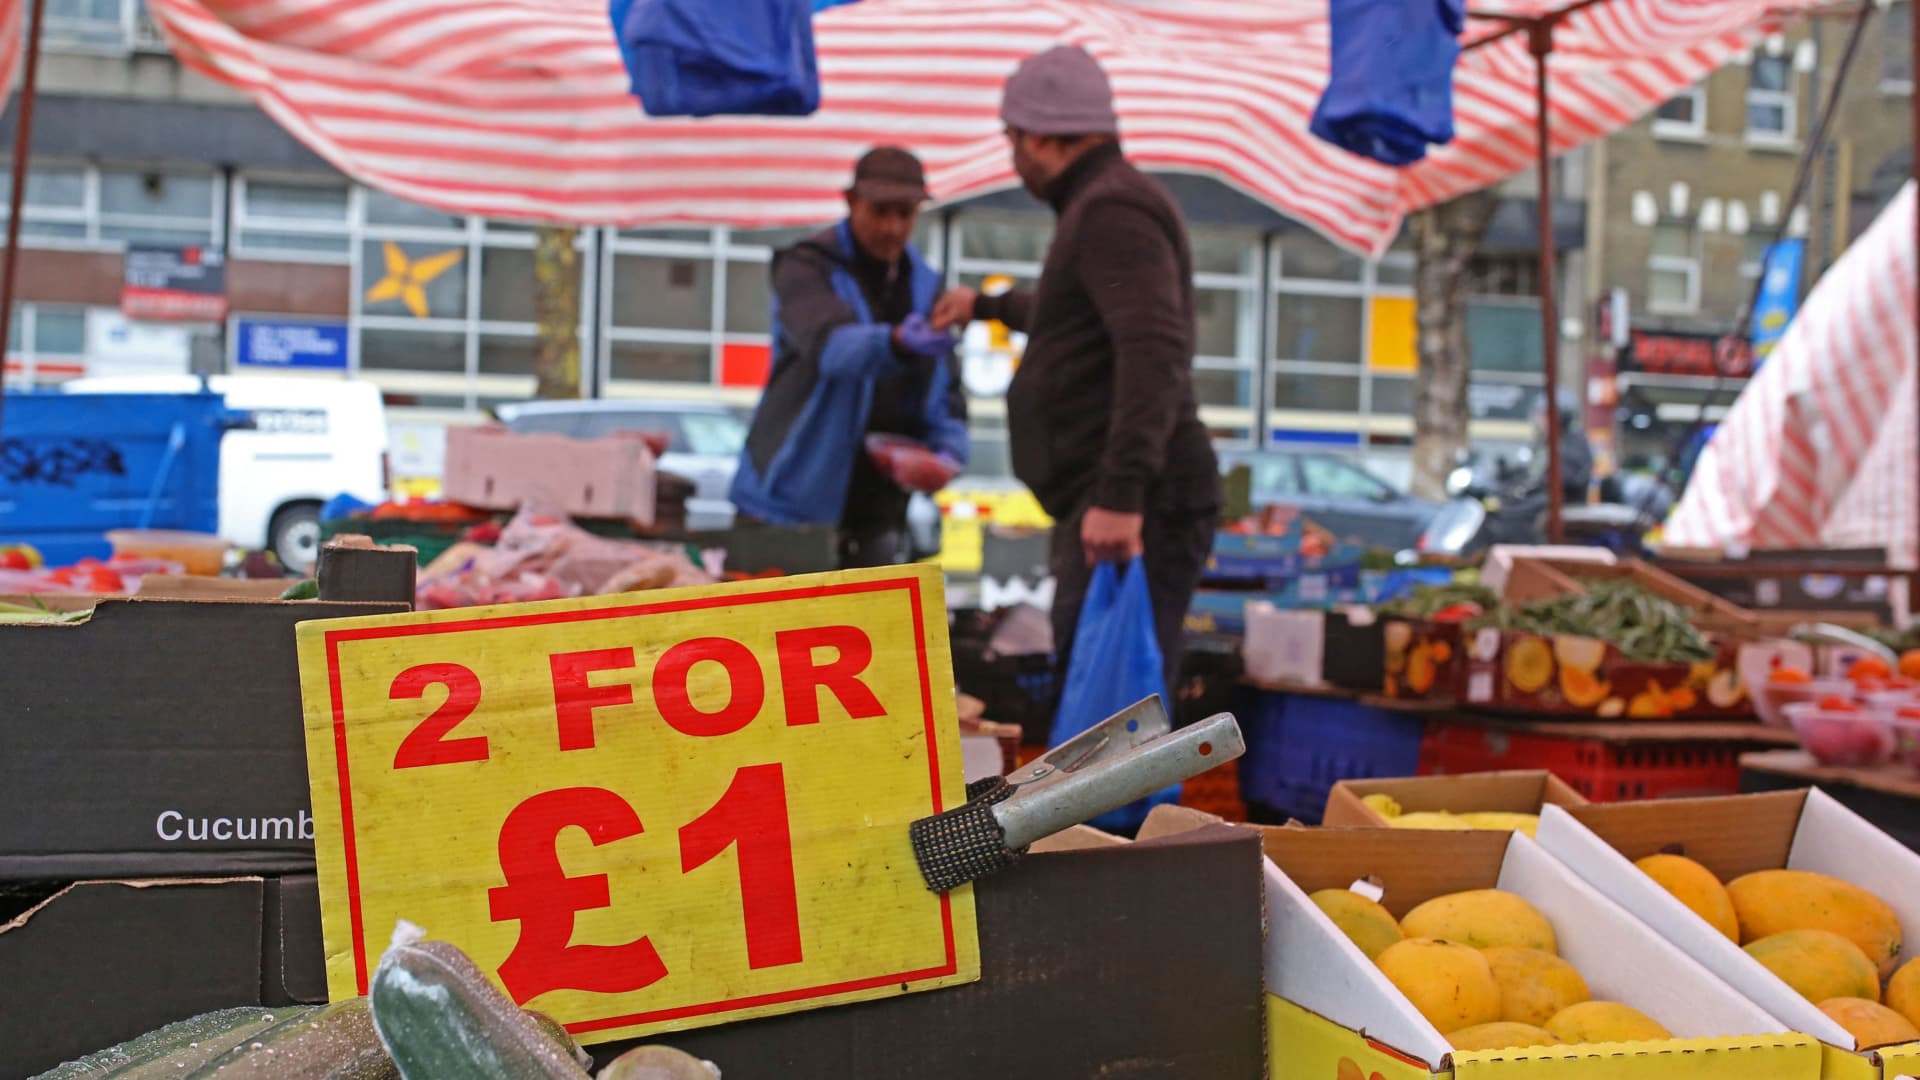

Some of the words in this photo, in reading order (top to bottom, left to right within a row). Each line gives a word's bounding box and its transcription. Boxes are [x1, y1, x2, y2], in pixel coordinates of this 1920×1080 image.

[389, 662, 489, 769] 2
[550, 625, 887, 751] FOR
[488, 763, 804, 1006] £1
